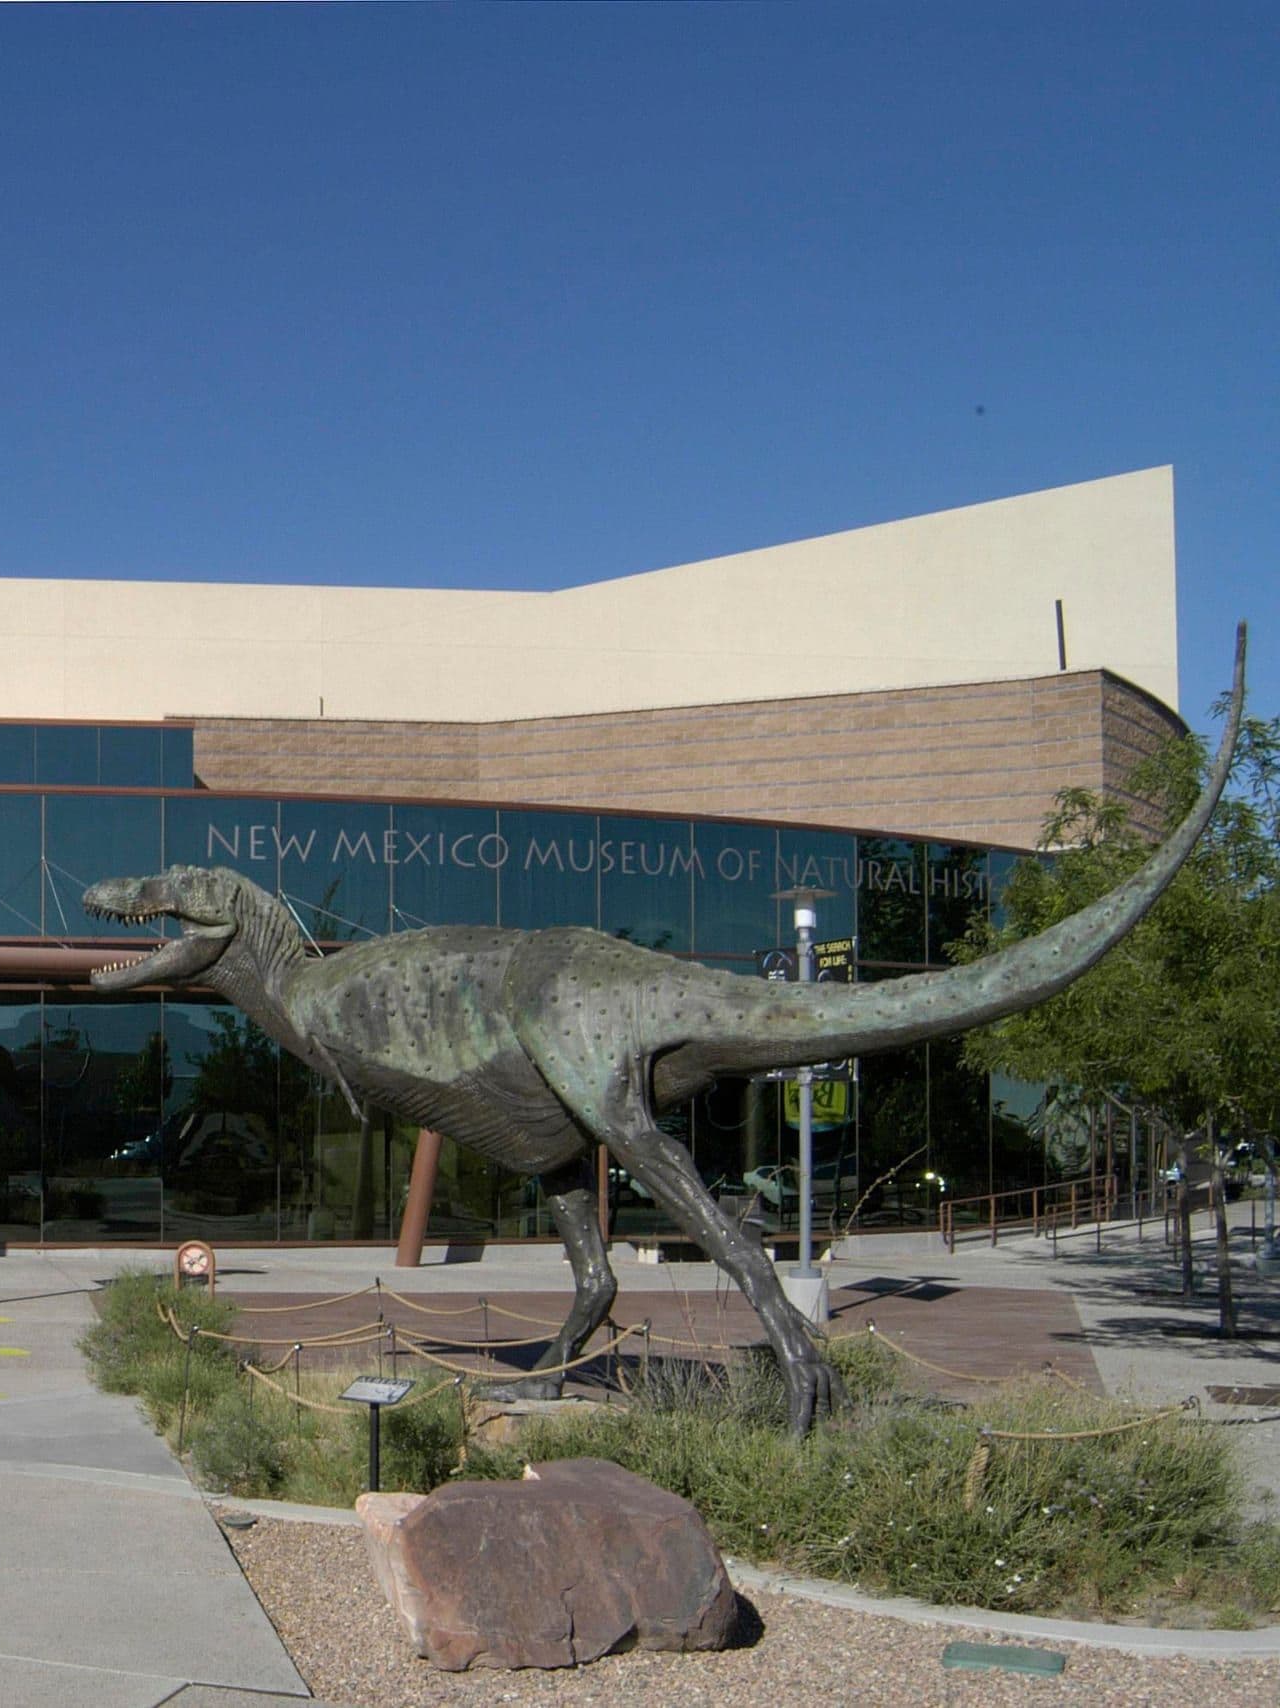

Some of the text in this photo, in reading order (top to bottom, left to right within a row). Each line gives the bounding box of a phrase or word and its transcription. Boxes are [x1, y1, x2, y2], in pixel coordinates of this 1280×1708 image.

[207, 823, 317, 863] NEW
[332, 829, 510, 868] MEXICO
[524, 837, 706, 880] MUSEUM
[717, 847, 762, 881] OF
[775, 852, 922, 896] NATURAL
